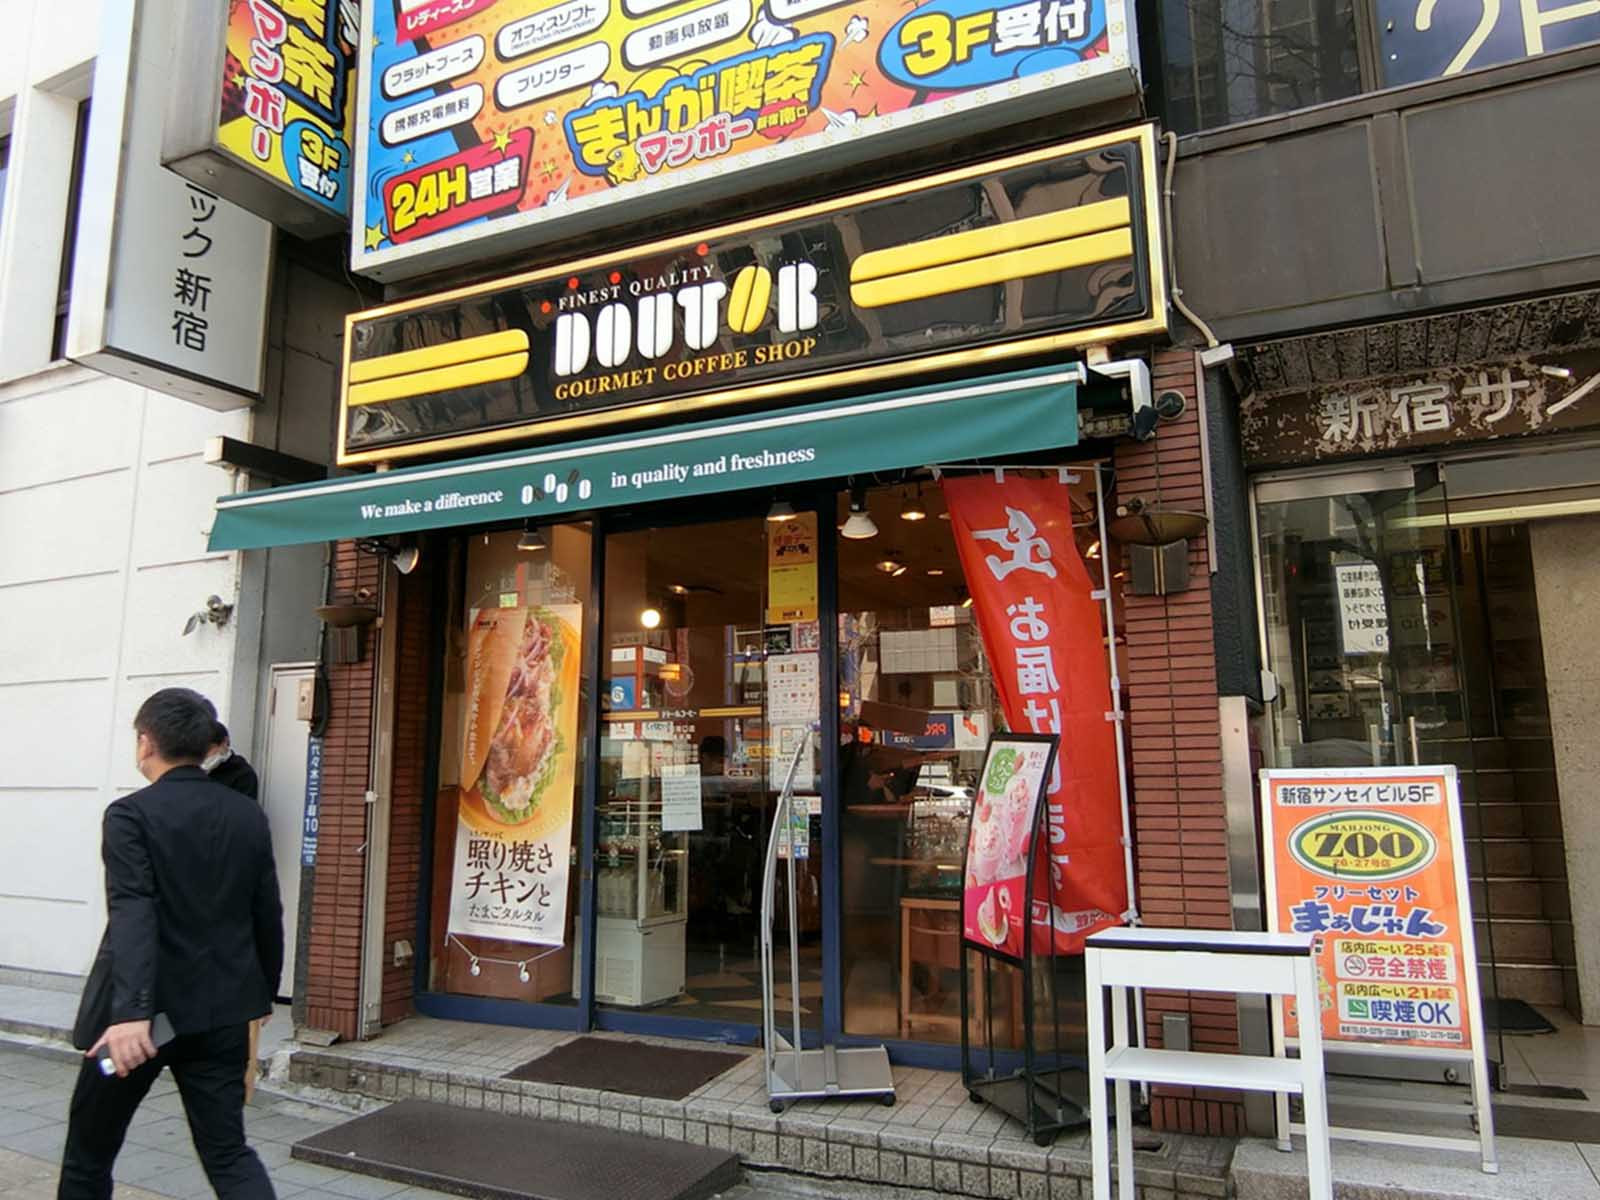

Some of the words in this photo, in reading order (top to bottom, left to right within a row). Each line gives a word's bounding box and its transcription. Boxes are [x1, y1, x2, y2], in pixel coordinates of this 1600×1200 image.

[511, 4, 597, 43] オフィスソフト
[648, 12, 730, 51] 動画見放題
[391, 47, 474, 87] フラットブース
[394, 97, 470, 132] 携帯充電無料
[572, 44, 823, 166] まんが喫茶
[301, 130, 340, 172] 3F
[638, 118, 752, 172] マンボー
[299, 156, 338, 200] 受付
[558, 286, 622, 311] FINEST
[629, 264, 716, 294] QUALITY
[554, 262, 819, 377] DOUTOR
[555, 367, 657, 401] GOURMET
[663, 350, 748, 381] COFFEE
[754, 337, 817, 365] SHOP
[361, 504, 383, 520] We
[385, 501, 422, 518] make
[424, 501, 432, 512] a
[435, 490, 503, 511] difference
[610, 472, 628, 489] in
[631, 463, 690, 489] quality
[692, 456, 727, 478] and
[730, 447, 816, 472] freshness
[1281, 785, 1435, 805] 新宿サンセイビル5F
[304, 818, 319, 833] 10
[1329, 823, 1391, 832] MAHJONG
[466, 839, 553, 874] 照り焼き
[1314, 831, 1415, 859] ZOO
[465, 871, 551, 908] チキンと
[1314, 885, 1419, 901] フリーセット
[468, 903, 545, 923] たまごタルタル
[1292, 901, 1446, 936] まぁじゃん
[1367, 956, 1447, 980] 完全禁煙
[1371, 1000, 1453, 1025] 喫煙OK
